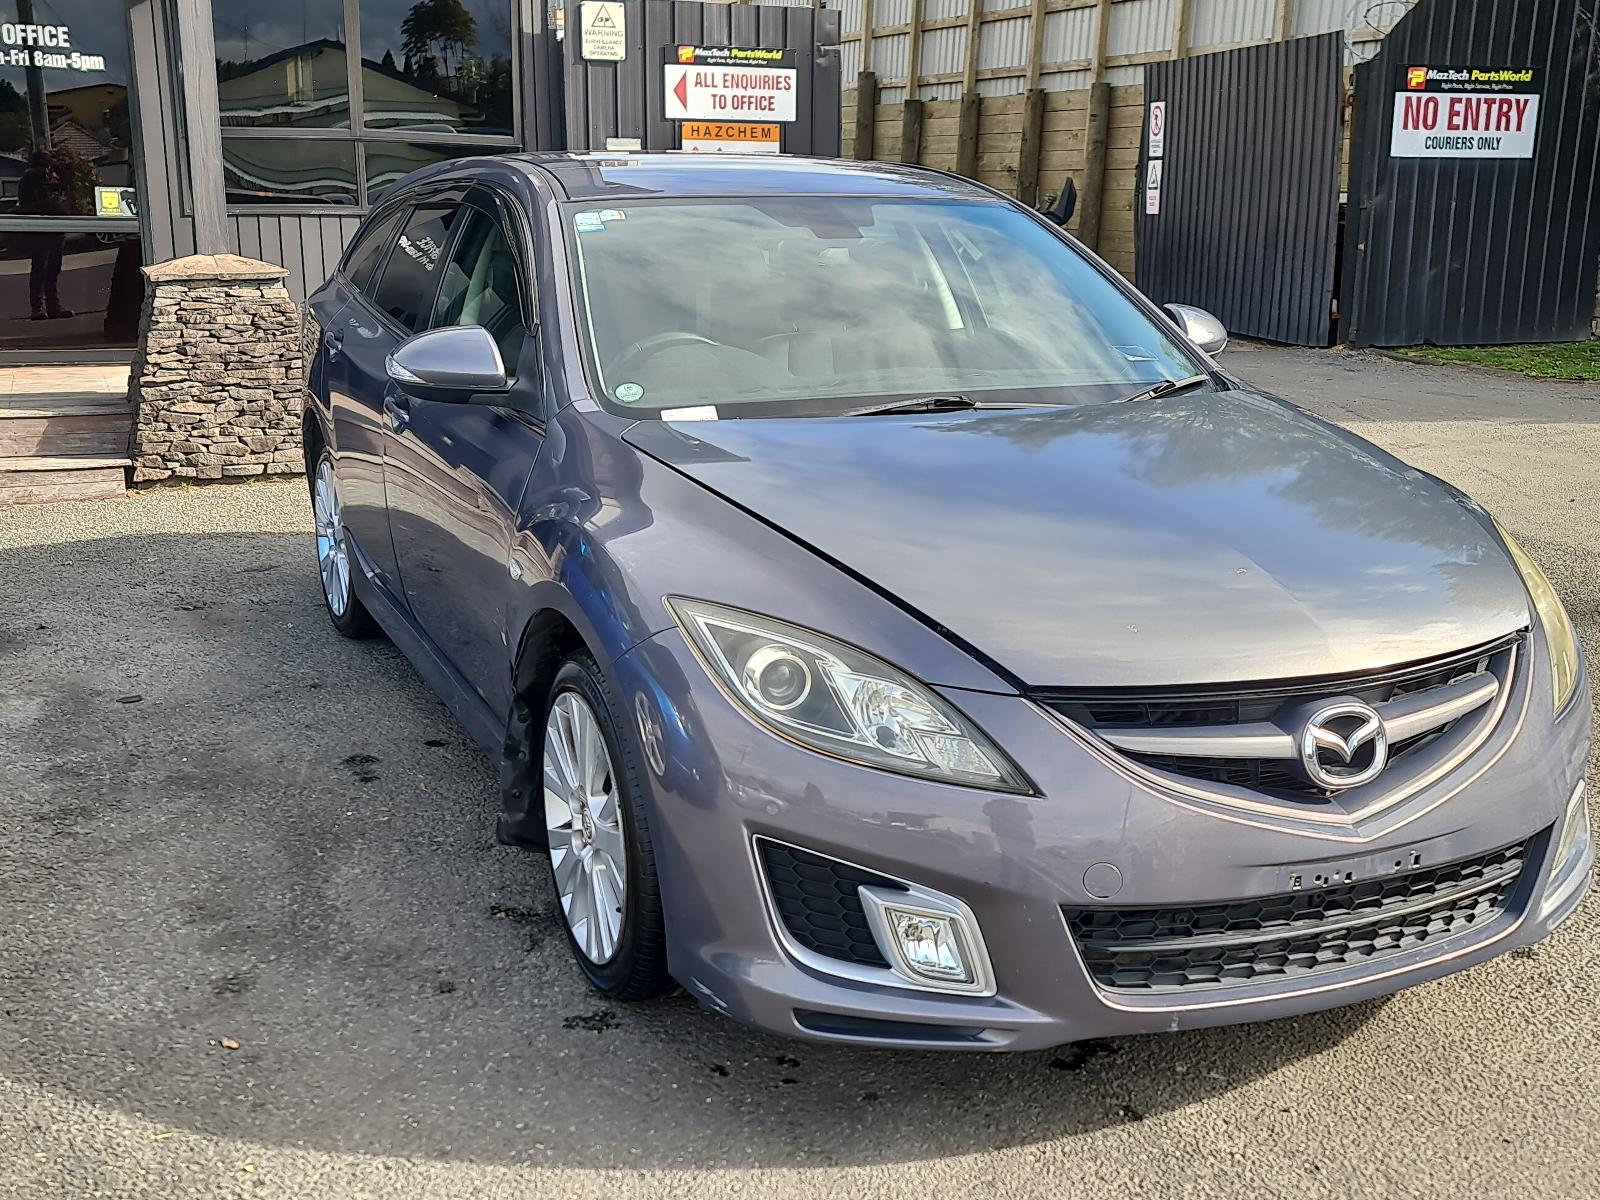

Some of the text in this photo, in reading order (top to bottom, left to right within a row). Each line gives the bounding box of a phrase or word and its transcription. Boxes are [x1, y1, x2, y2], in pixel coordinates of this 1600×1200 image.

[1, 23, 71, 48] OFFICE
[584, 29, 624, 38] WARNING
[33, 50, 106, 72] 8am-5pm
[731, 48, 783, 60] PartsWorld
[694, 72, 792, 91] ALL ENQUIRIES
[1426, 69, 1470, 80] MazTech
[1471, 69, 1533, 82] PartsWorld
[711, 93, 776, 111] TO OFFICE
[1402, 95, 1531, 132] NO ENTRY
[690, 125, 772, 139] HAZCHEM
[1424, 136, 1502, 151] COURIERS ONLY
